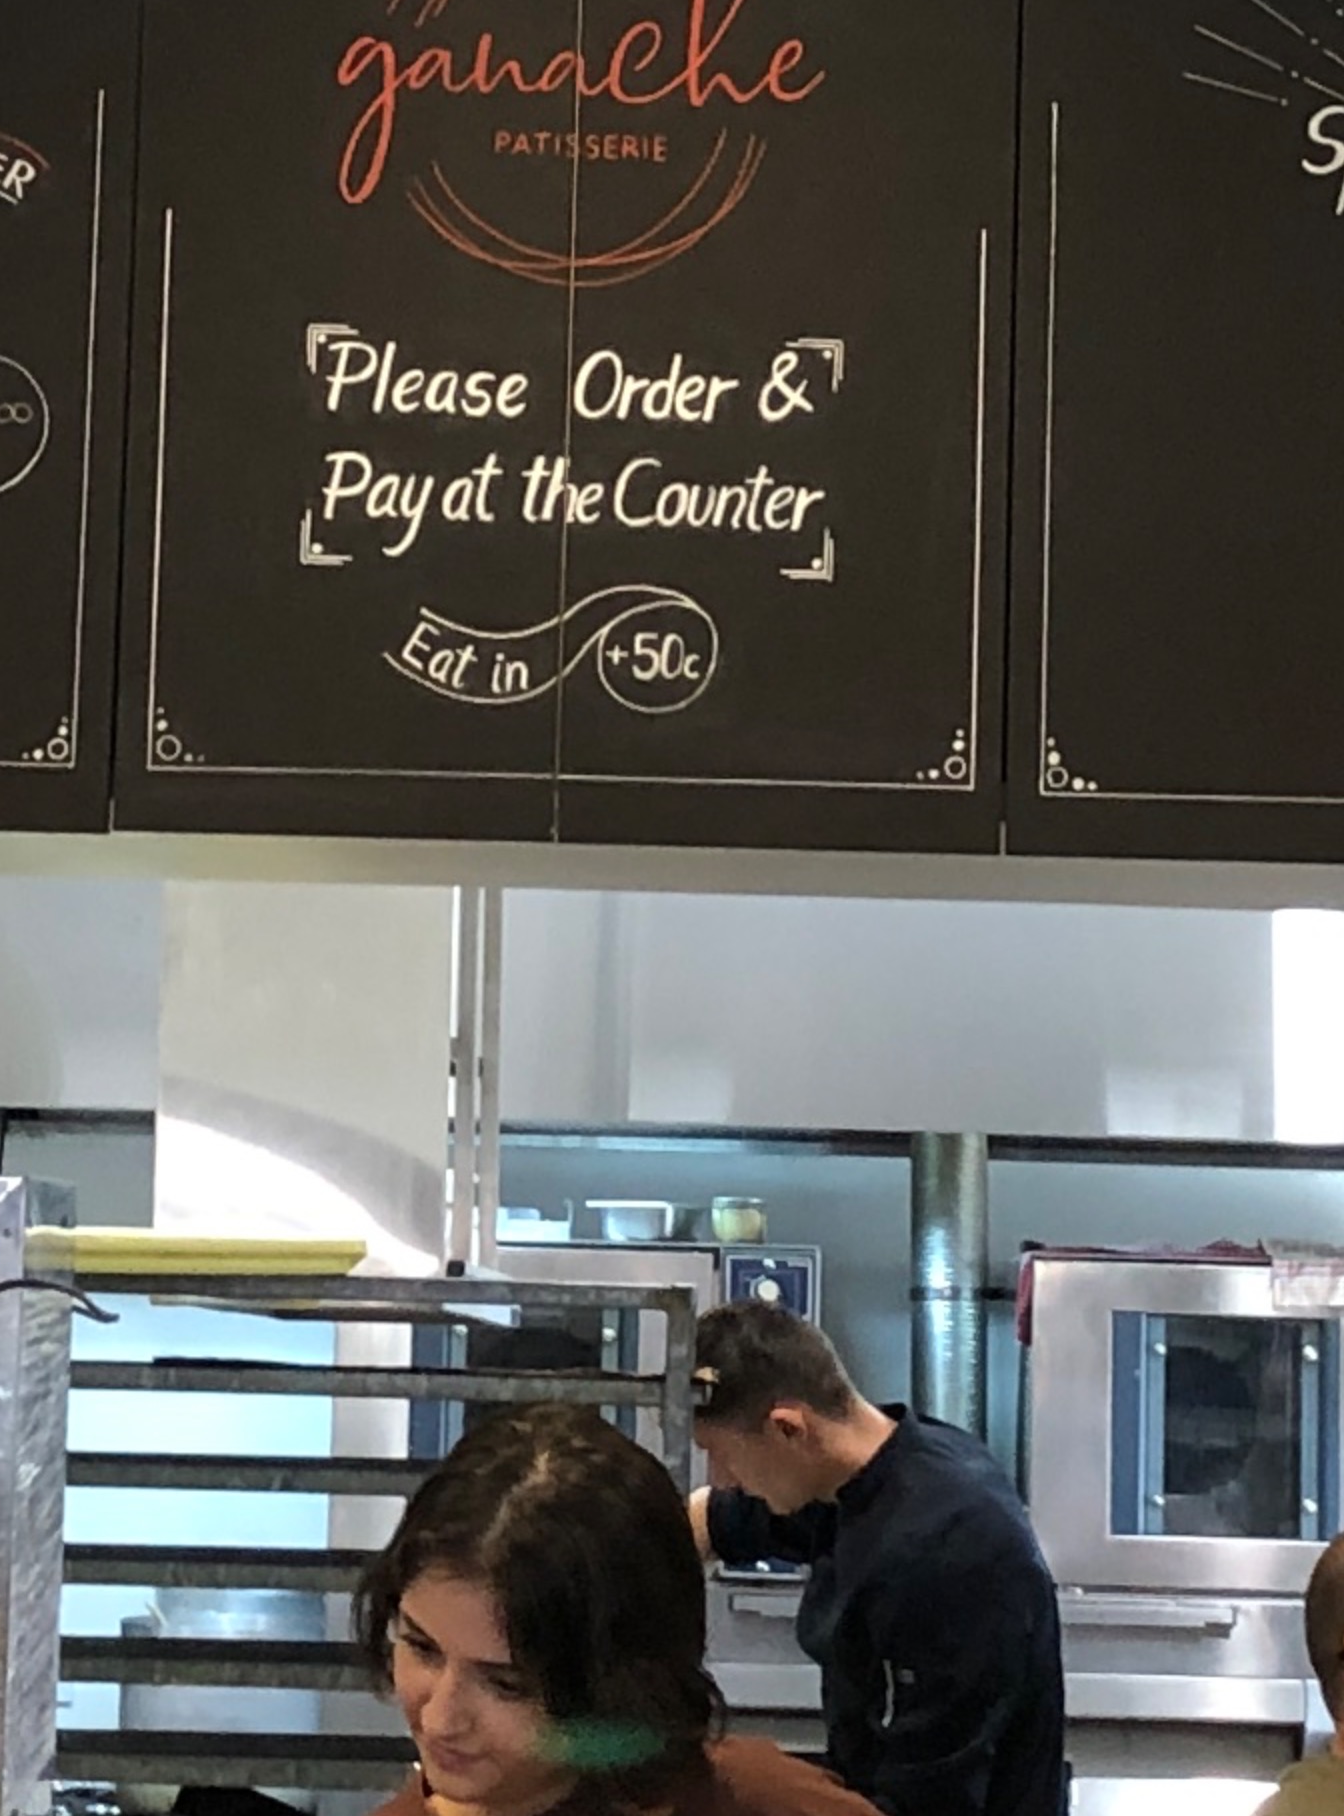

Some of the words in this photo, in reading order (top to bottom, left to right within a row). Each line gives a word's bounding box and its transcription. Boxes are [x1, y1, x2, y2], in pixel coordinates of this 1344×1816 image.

[494, 130, 668, 162] PATISSERIE
[325, 341, 529, 419] Please
[573, 350, 739, 422] Order
[757, 351, 814, 422] &
[323, 451, 435, 557] Pay
[442, 454, 503, 522] at
[522, 454, 604, 525] the
[613, 458, 825, 533] Counter
[401, 621, 478, 689] Eat
[491, 653, 530, 693] in
[605, 631, 700, 682] +50c
